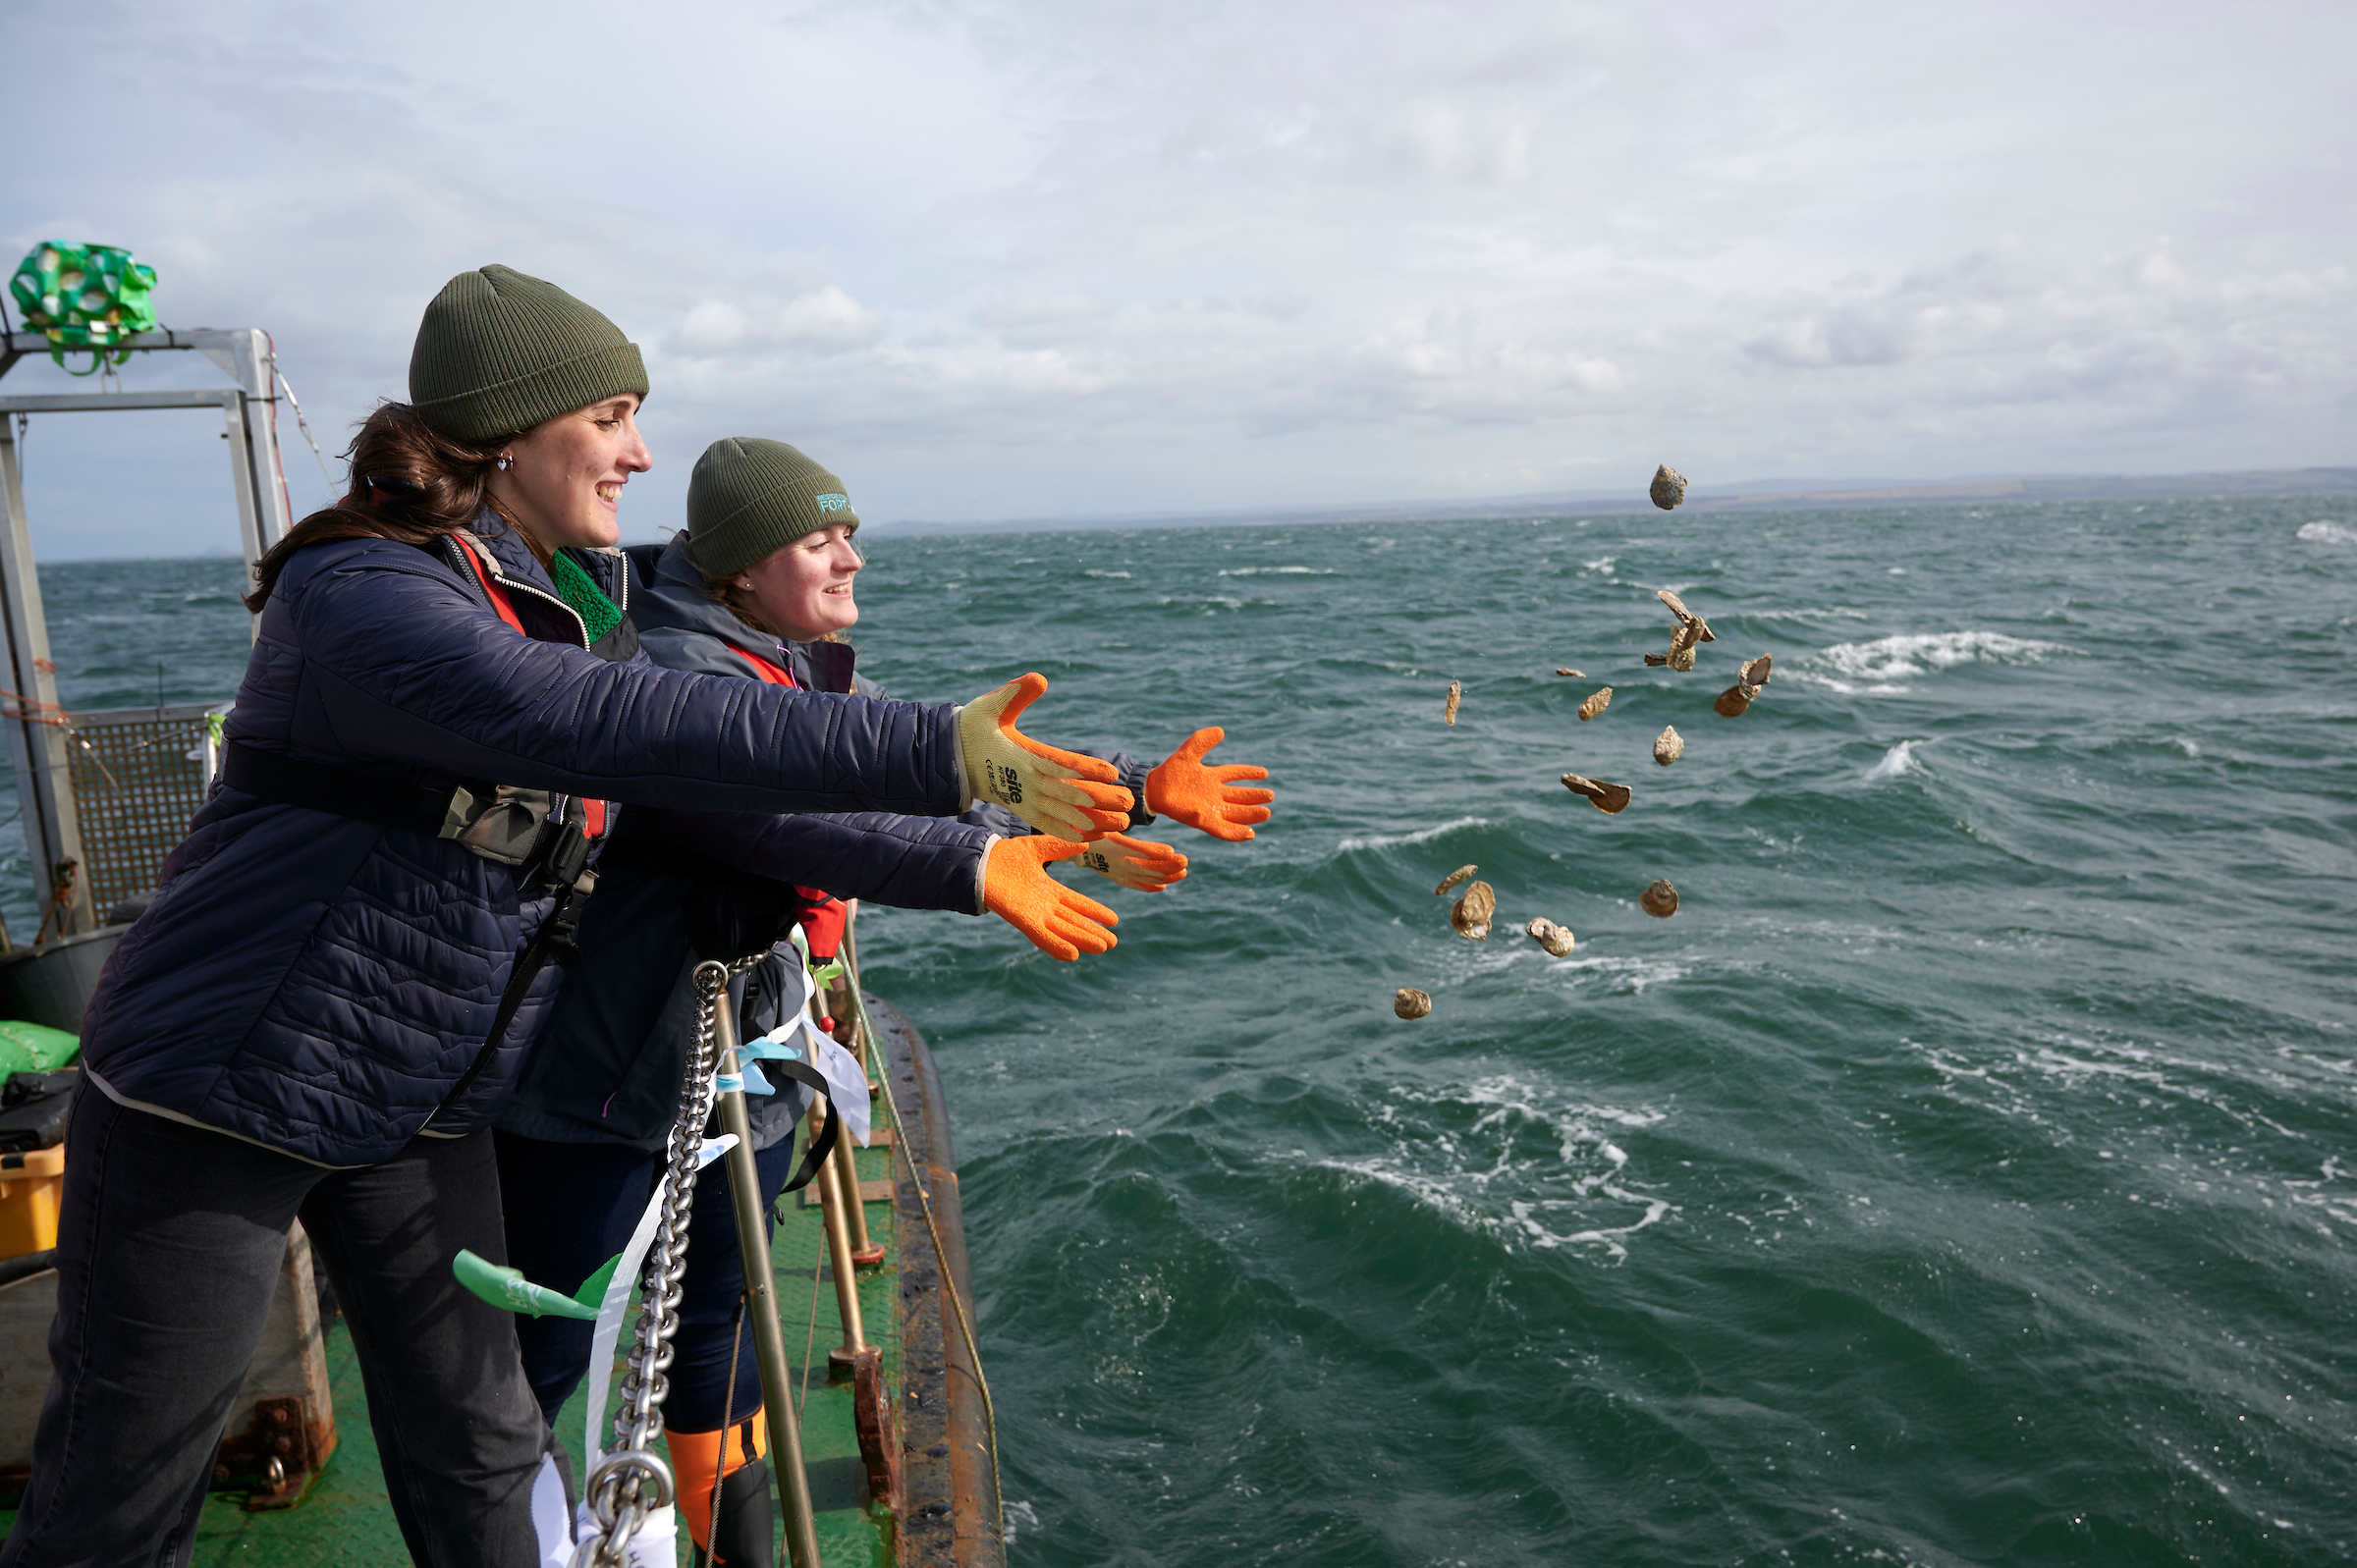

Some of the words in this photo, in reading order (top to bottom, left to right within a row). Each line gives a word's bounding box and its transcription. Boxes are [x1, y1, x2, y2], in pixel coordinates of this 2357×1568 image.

[819, 500, 850, 513] FORT
[1005, 766, 1022, 804] site
[1095, 852, 1110, 873] site
